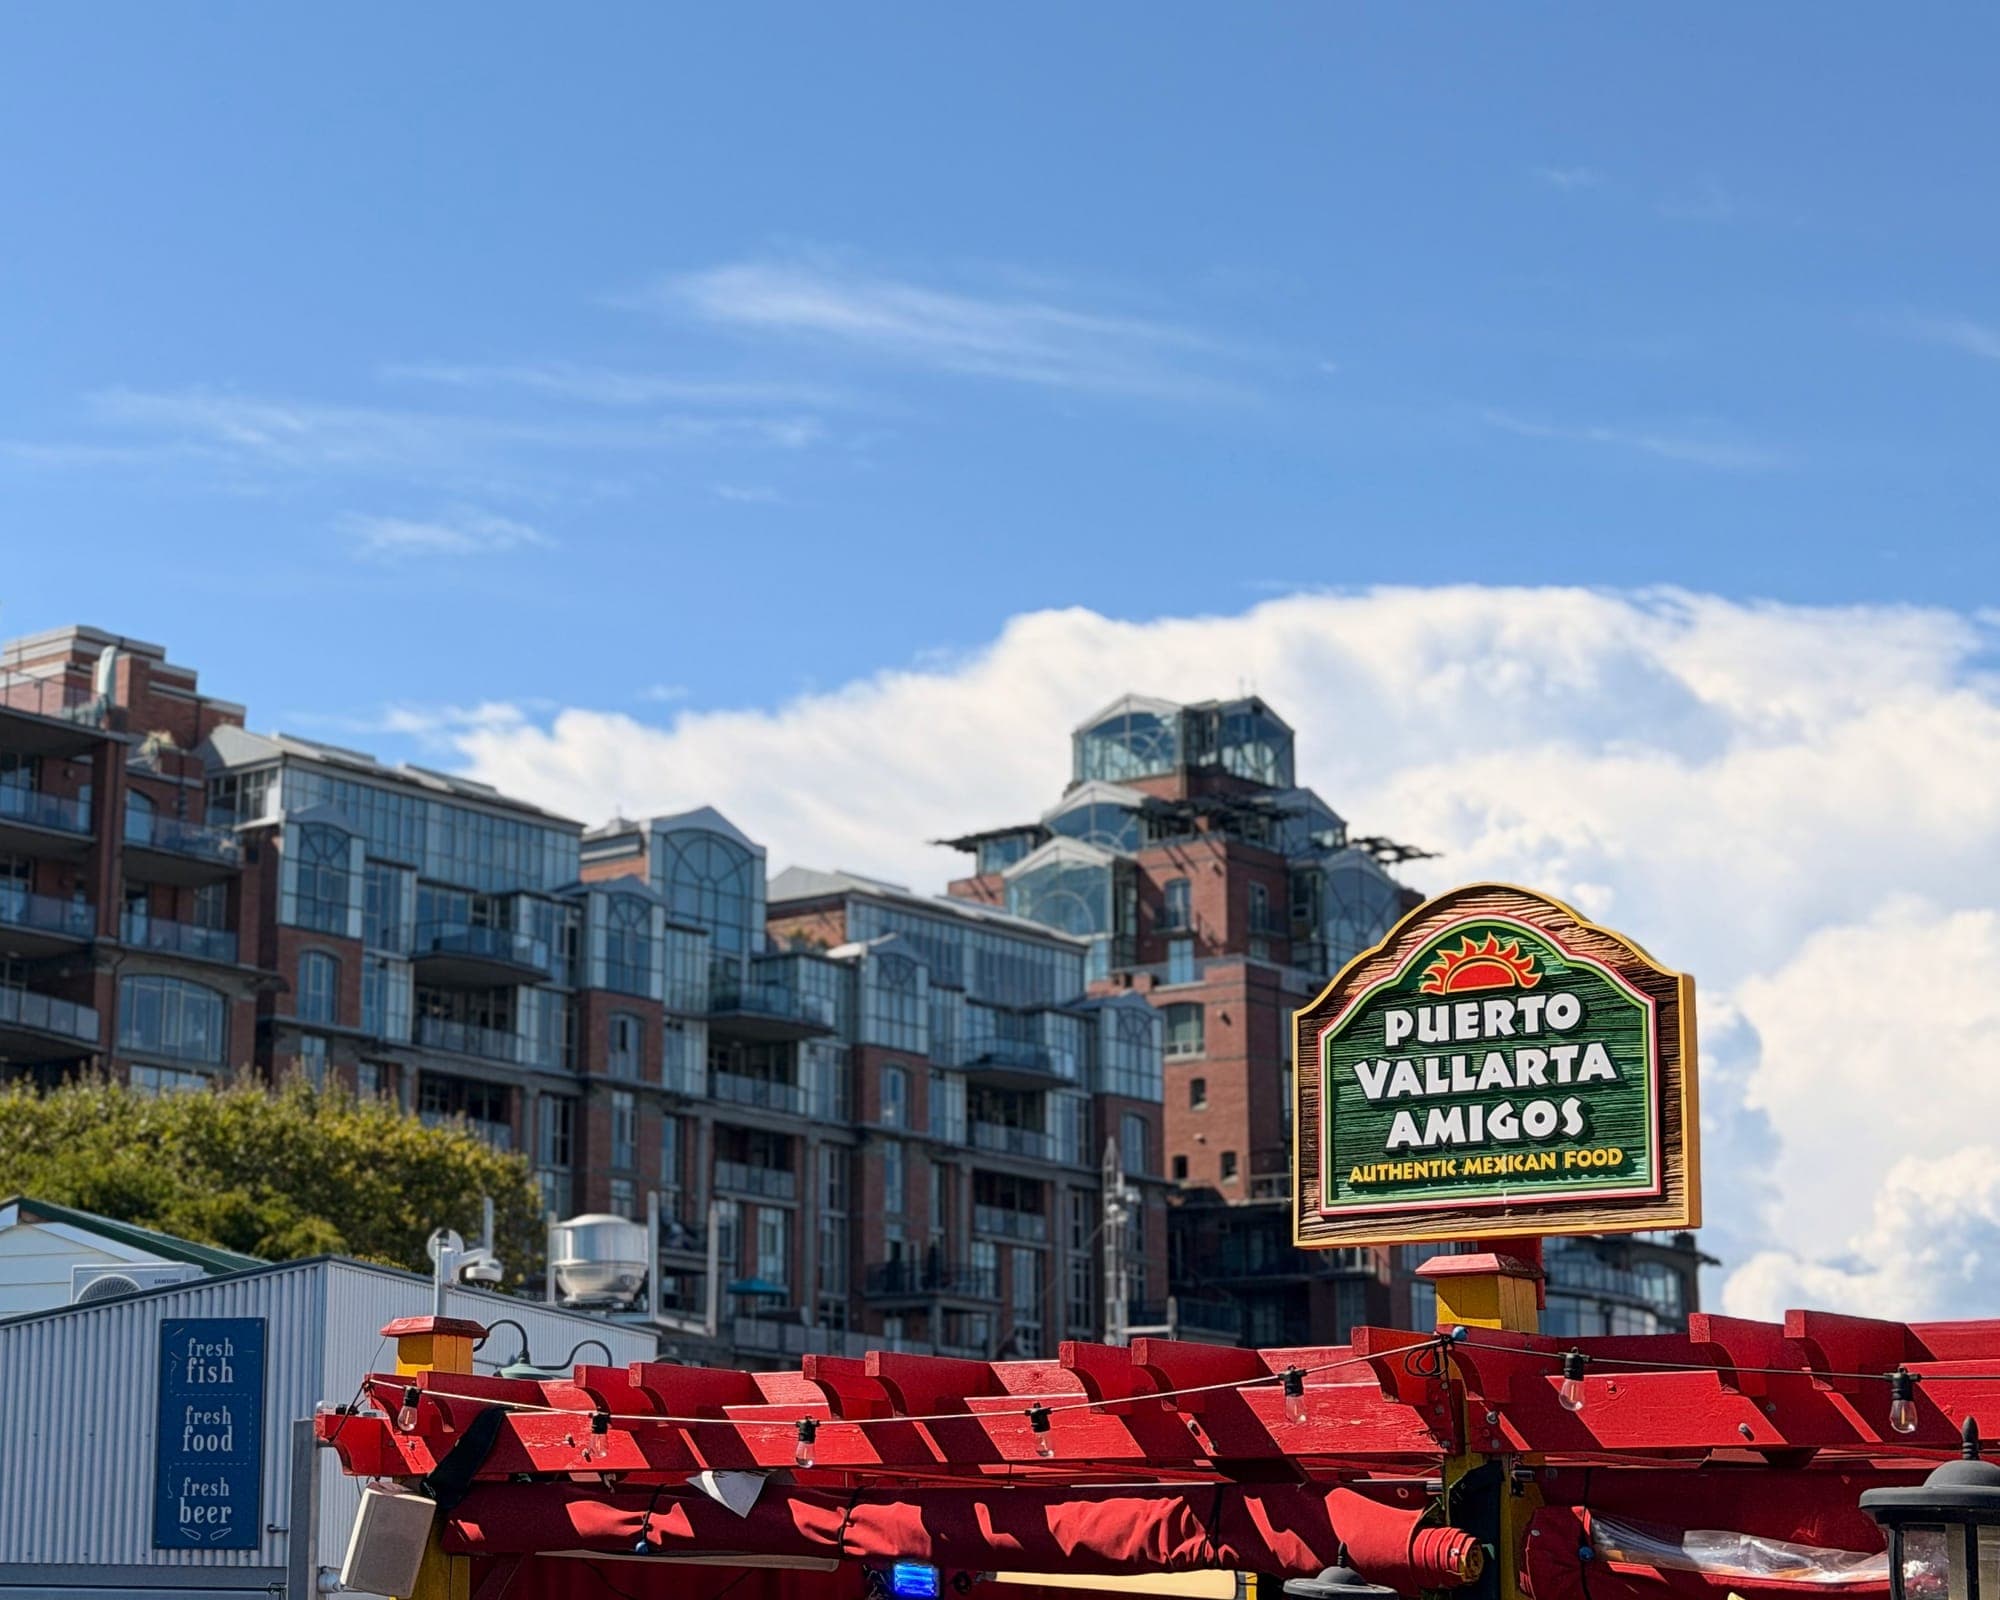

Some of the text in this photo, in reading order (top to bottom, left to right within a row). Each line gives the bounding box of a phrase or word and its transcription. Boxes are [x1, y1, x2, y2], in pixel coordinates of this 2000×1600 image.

[1384, 993, 1582, 1047] PUERTO
[1353, 1041, 1617, 1100] VALLARTA
[1386, 1097, 1584, 1149] AMIGOS
[1349, 1148, 1623, 1183] AUTHENTIC MEXICAN FOOD
[187, 1337, 234, 1357] fresh
[186, 1357, 234, 1383] fish
[185, 1405, 232, 1425] fresh
[182, 1425, 233, 1452] food
[183, 1477, 230, 1497] fresh
[179, 1497, 232, 1523] beer
